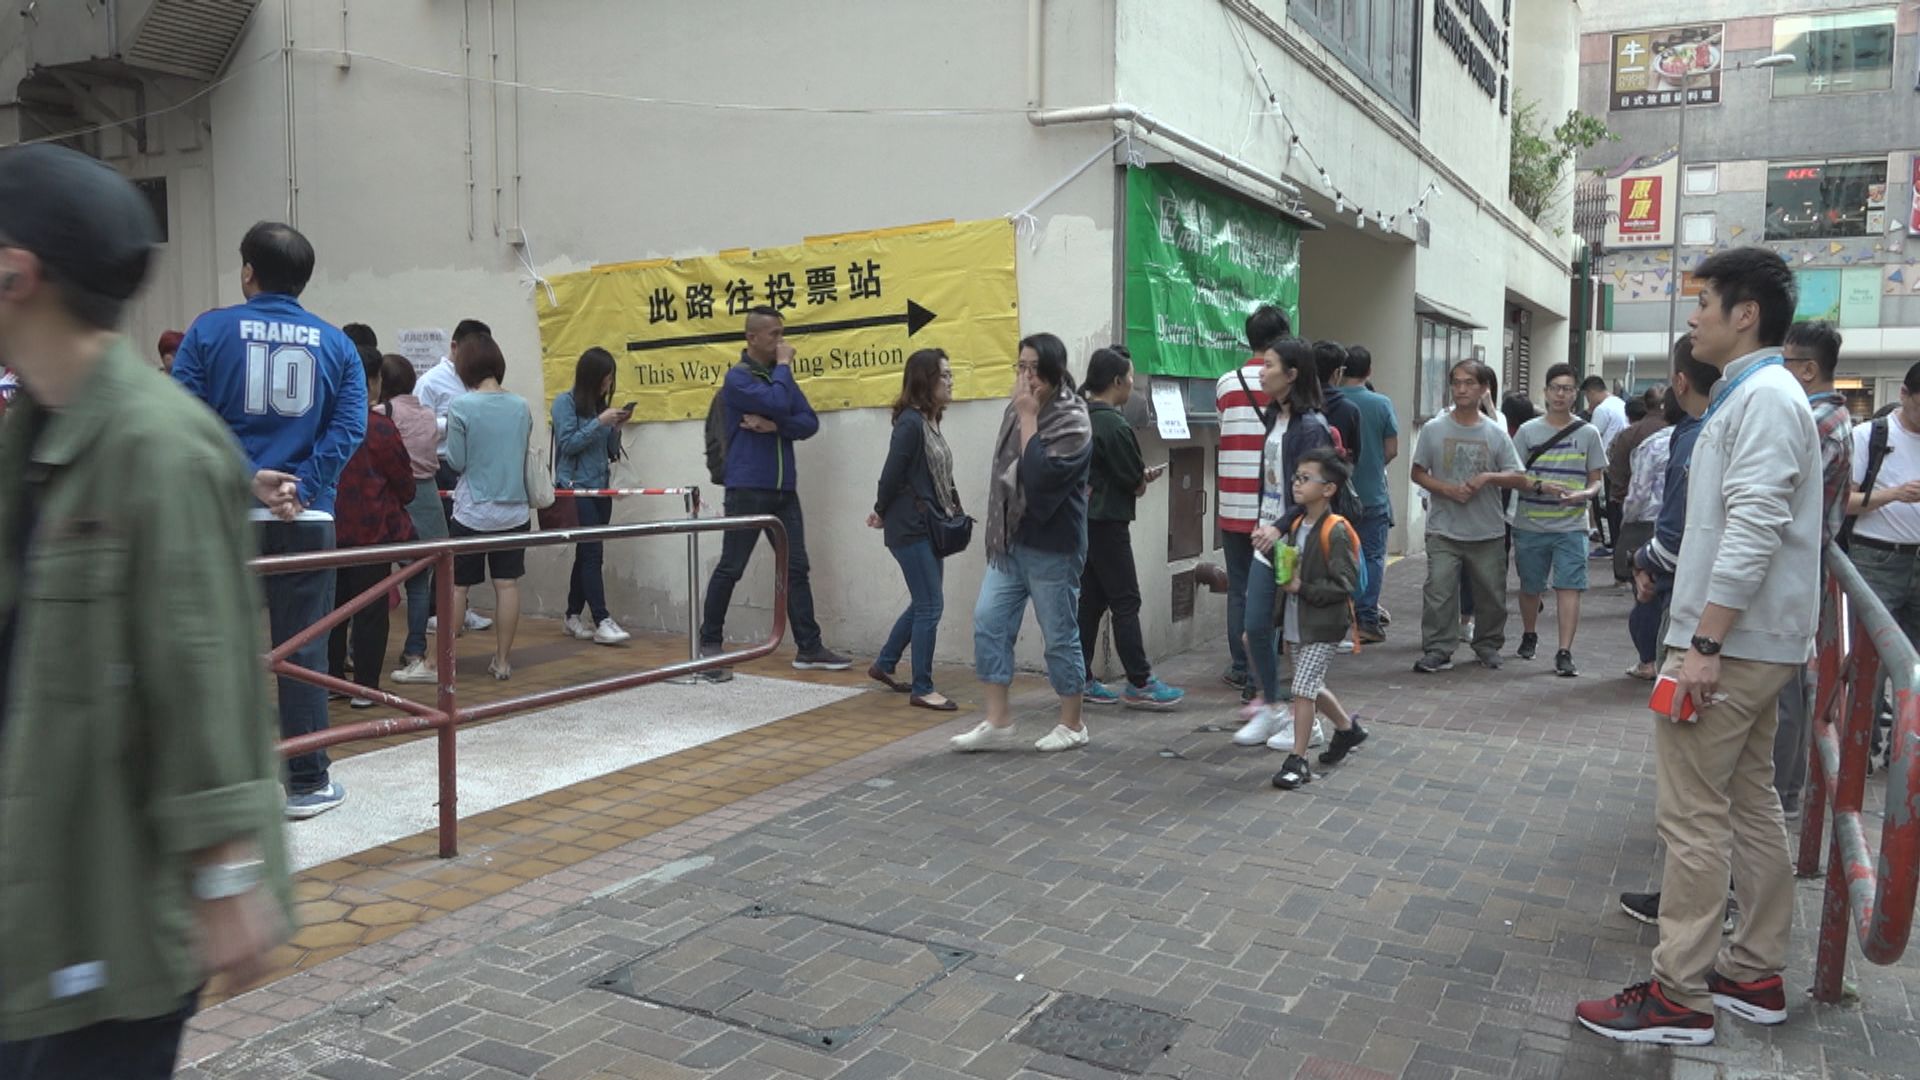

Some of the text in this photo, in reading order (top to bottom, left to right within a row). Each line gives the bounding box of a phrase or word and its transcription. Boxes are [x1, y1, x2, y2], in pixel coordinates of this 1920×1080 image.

[1785, 168, 1817, 179] KFC
[648, 259, 882, 325] 此路往投票站
[240, 319, 321, 347] FRANCE
[244, 341, 317, 417] 10
[635, 364, 674, 386] This
[681, 360, 721, 385] Way
[830, 344, 904, 371] Station
